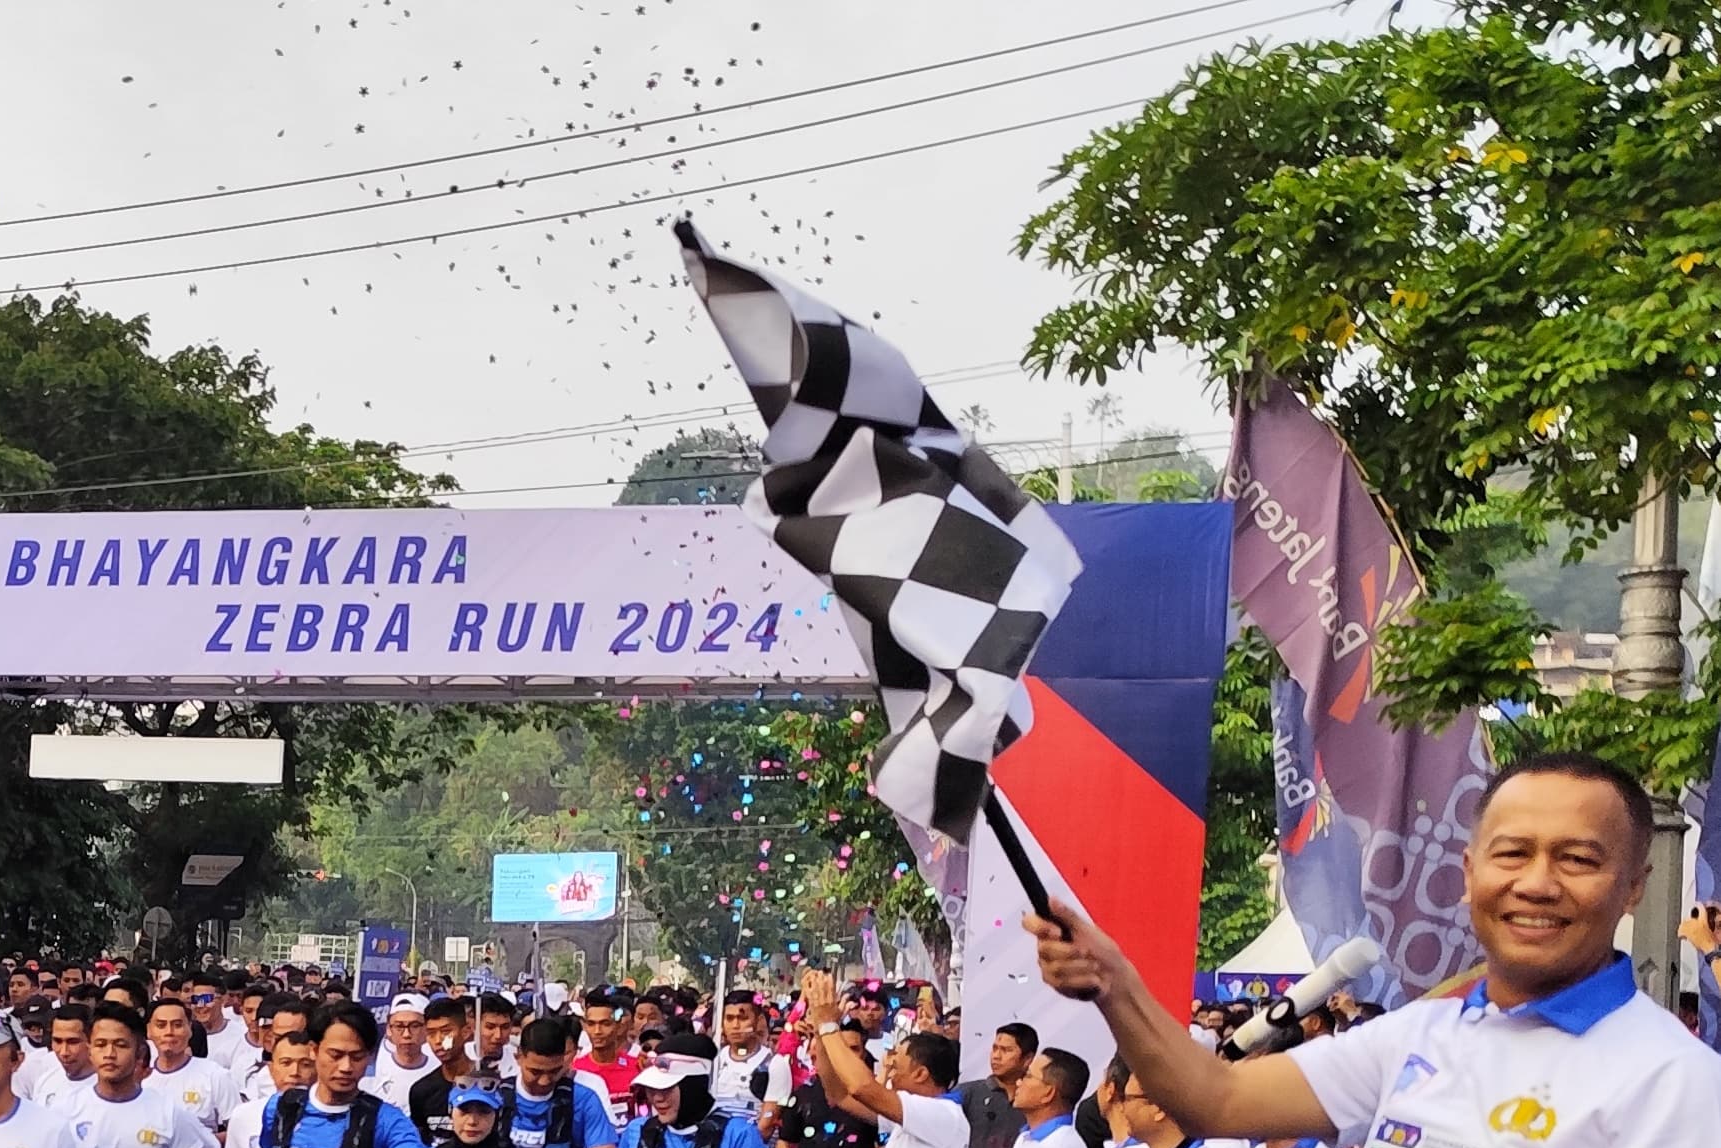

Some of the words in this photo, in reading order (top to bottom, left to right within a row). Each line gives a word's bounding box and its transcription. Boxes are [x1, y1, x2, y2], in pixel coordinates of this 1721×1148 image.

[5, 535, 467, 587] BHAYANGKARA
[205, 602, 410, 653] ZEBRA
[448, 602, 585, 653] RUN
[609, 602, 783, 654] 2024
